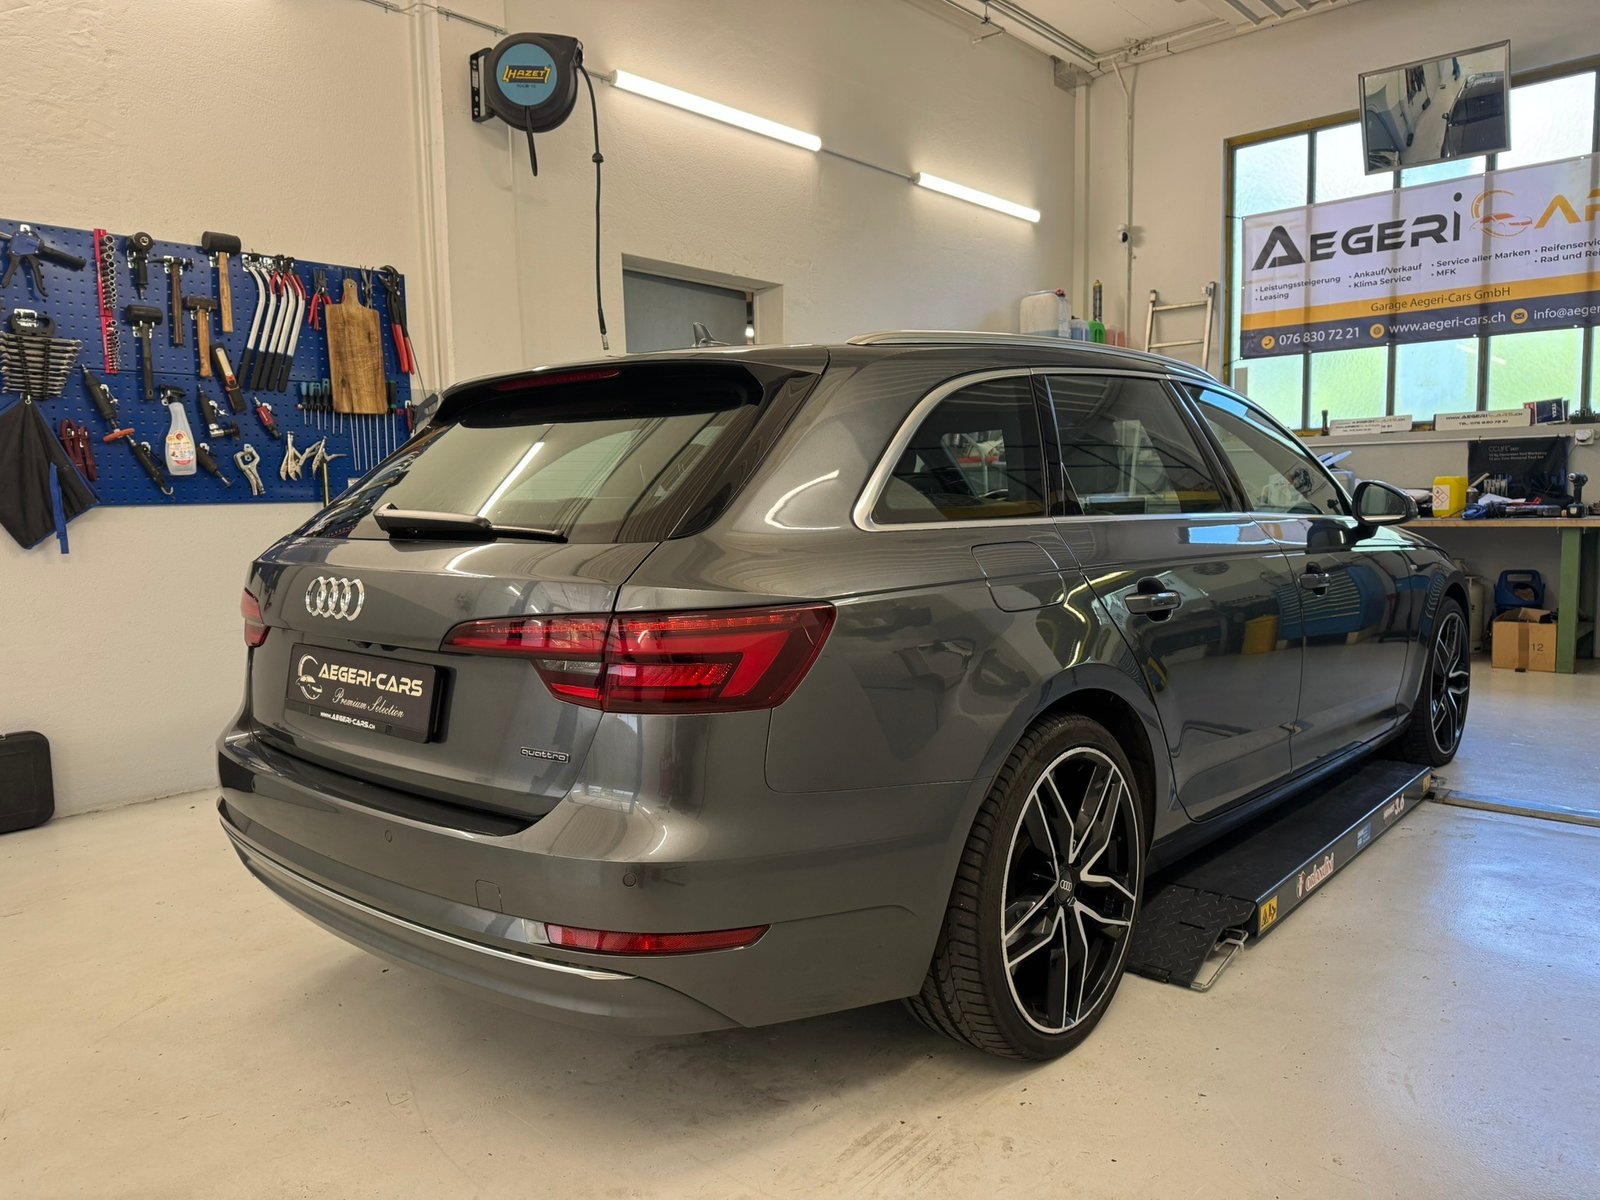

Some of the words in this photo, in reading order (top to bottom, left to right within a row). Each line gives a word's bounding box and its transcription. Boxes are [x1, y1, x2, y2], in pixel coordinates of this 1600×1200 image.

[506, 68, 547, 80] HAZET
[1436, 257, 1470, 268] Service
[1471, 254, 1493, 264] aller
[1494, 249, 1531, 260] Marken
[1540, 254, 1560, 264] Rad
[1562, 250, 1582, 261] und
[1353, 262, 1422, 279] Ankauf/Verkauf
[1436, 268, 1457, 277] MFK
[1259, 275, 1341, 293] Leistungssteigerung
[1353, 278, 1378, 288] Klima
[1379, 275, 1412, 285] Service
[1259, 291, 1290, 302] Leasing
[1371, 299, 1408, 312] Garage
[1410, 292, 1471, 308] Aegeri-Cars
[1474, 286, 1511, 301] GmbH
[1388, 311, 1506, 334] www.aegeri-cars.ch
[1279, 333, 1301, 346] 076
[1303, 331, 1325, 344] 830
[1328, 329, 1343, 341] 72
[1346, 327, 1360, 339] 21
[1530, 643, 1544, 652] 12
[318, 662, 423, 697] AEGERI-CARS
[332, 687, 367, 710] Premium
[367, 695, 405, 718] Selection
[521, 748, 566, 761] quattro
